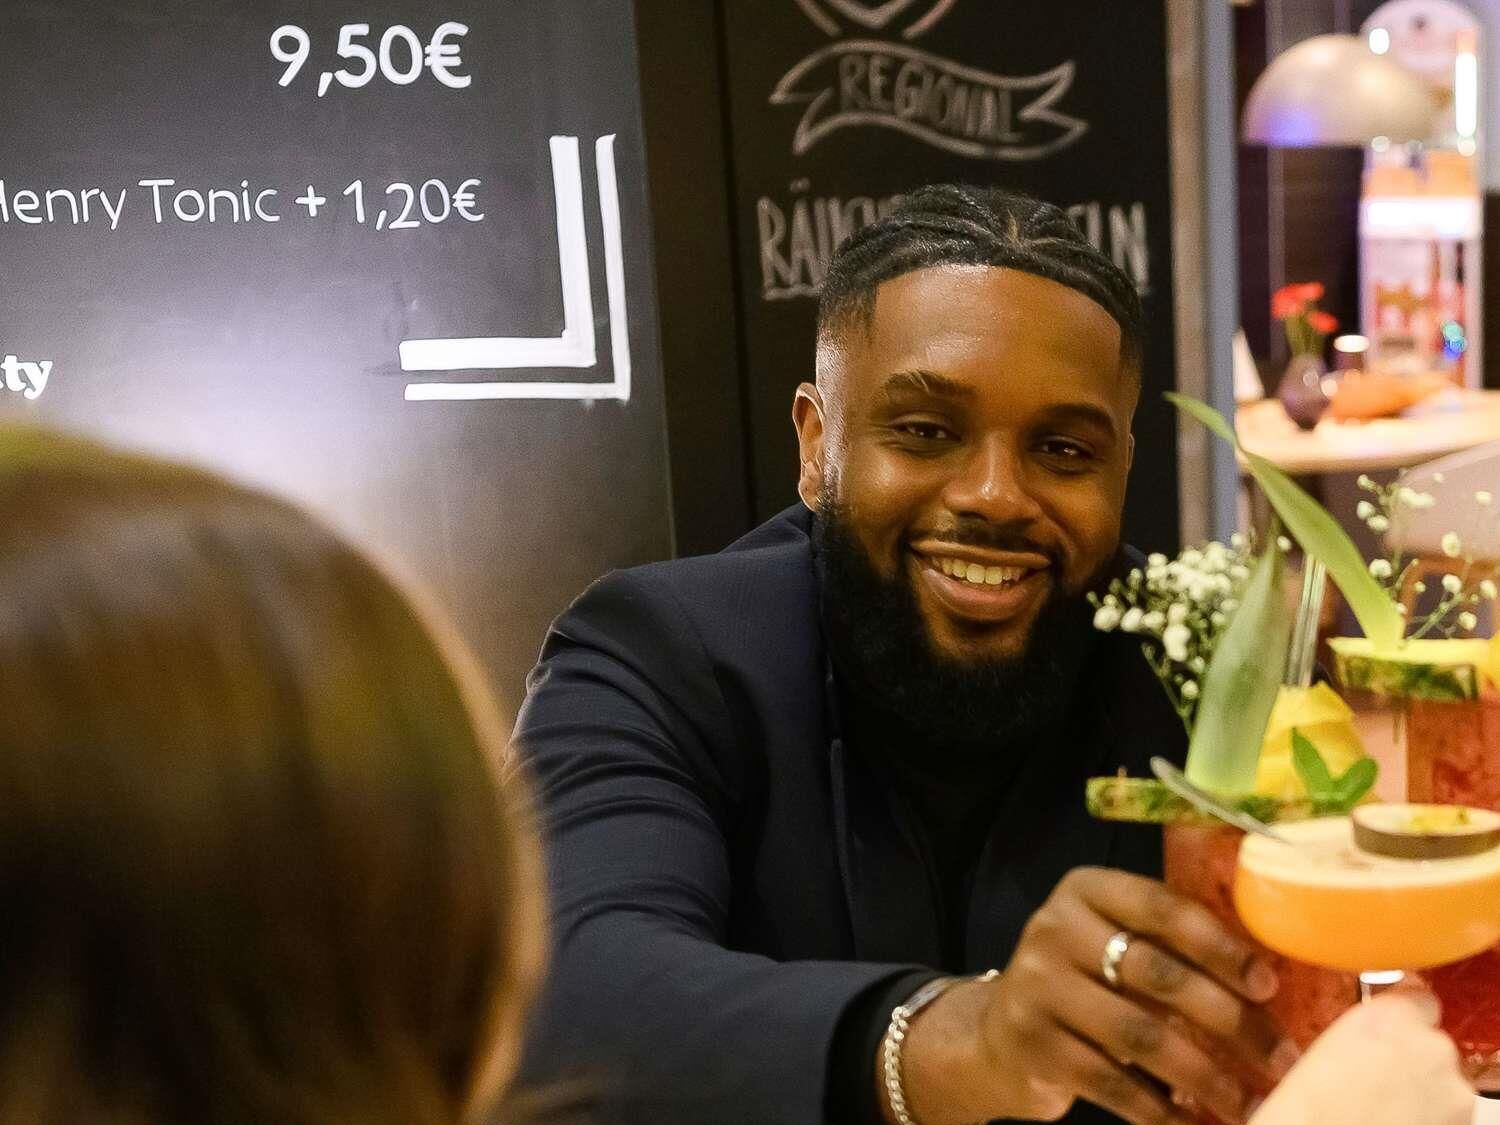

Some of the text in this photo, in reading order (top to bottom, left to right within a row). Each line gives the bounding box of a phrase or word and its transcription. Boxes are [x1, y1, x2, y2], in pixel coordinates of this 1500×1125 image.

[268, 21, 472, 98] 9,50€
[839, 54, 1024, 143] REGIONAL
[137, 178, 281, 224] Tonic
[294, 184, 327, 217] +
[342, 178, 485, 231] 1,20€
[0, 355, 53, 400] ty
